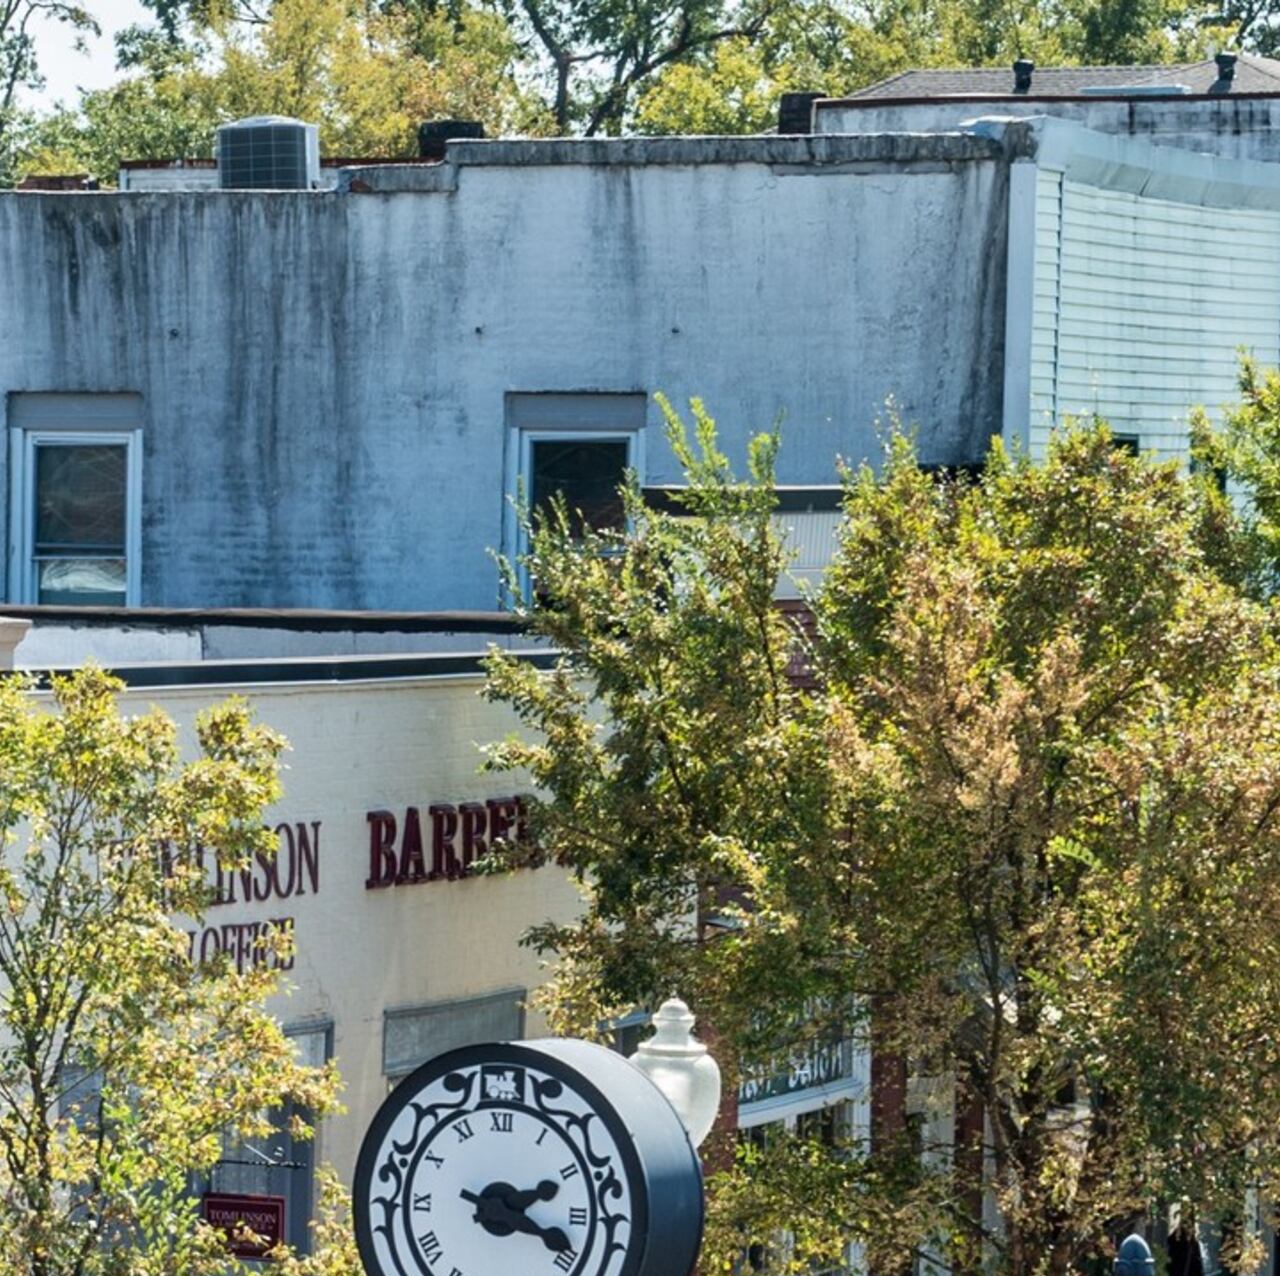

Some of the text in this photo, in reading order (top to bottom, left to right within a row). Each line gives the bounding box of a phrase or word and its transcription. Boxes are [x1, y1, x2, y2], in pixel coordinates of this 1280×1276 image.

[452, 1118, 475, 1143] XI
[490, 1112, 514, 1132] XII
[536, 1127, 549, 1145] I
[424, 1150, 445, 1169] X
[559, 1162, 579, 1180] II
[413, 1192, 432, 1213] IX
[569, 1207, 587, 1226] III
[418, 1230, 443, 1266] VIII
